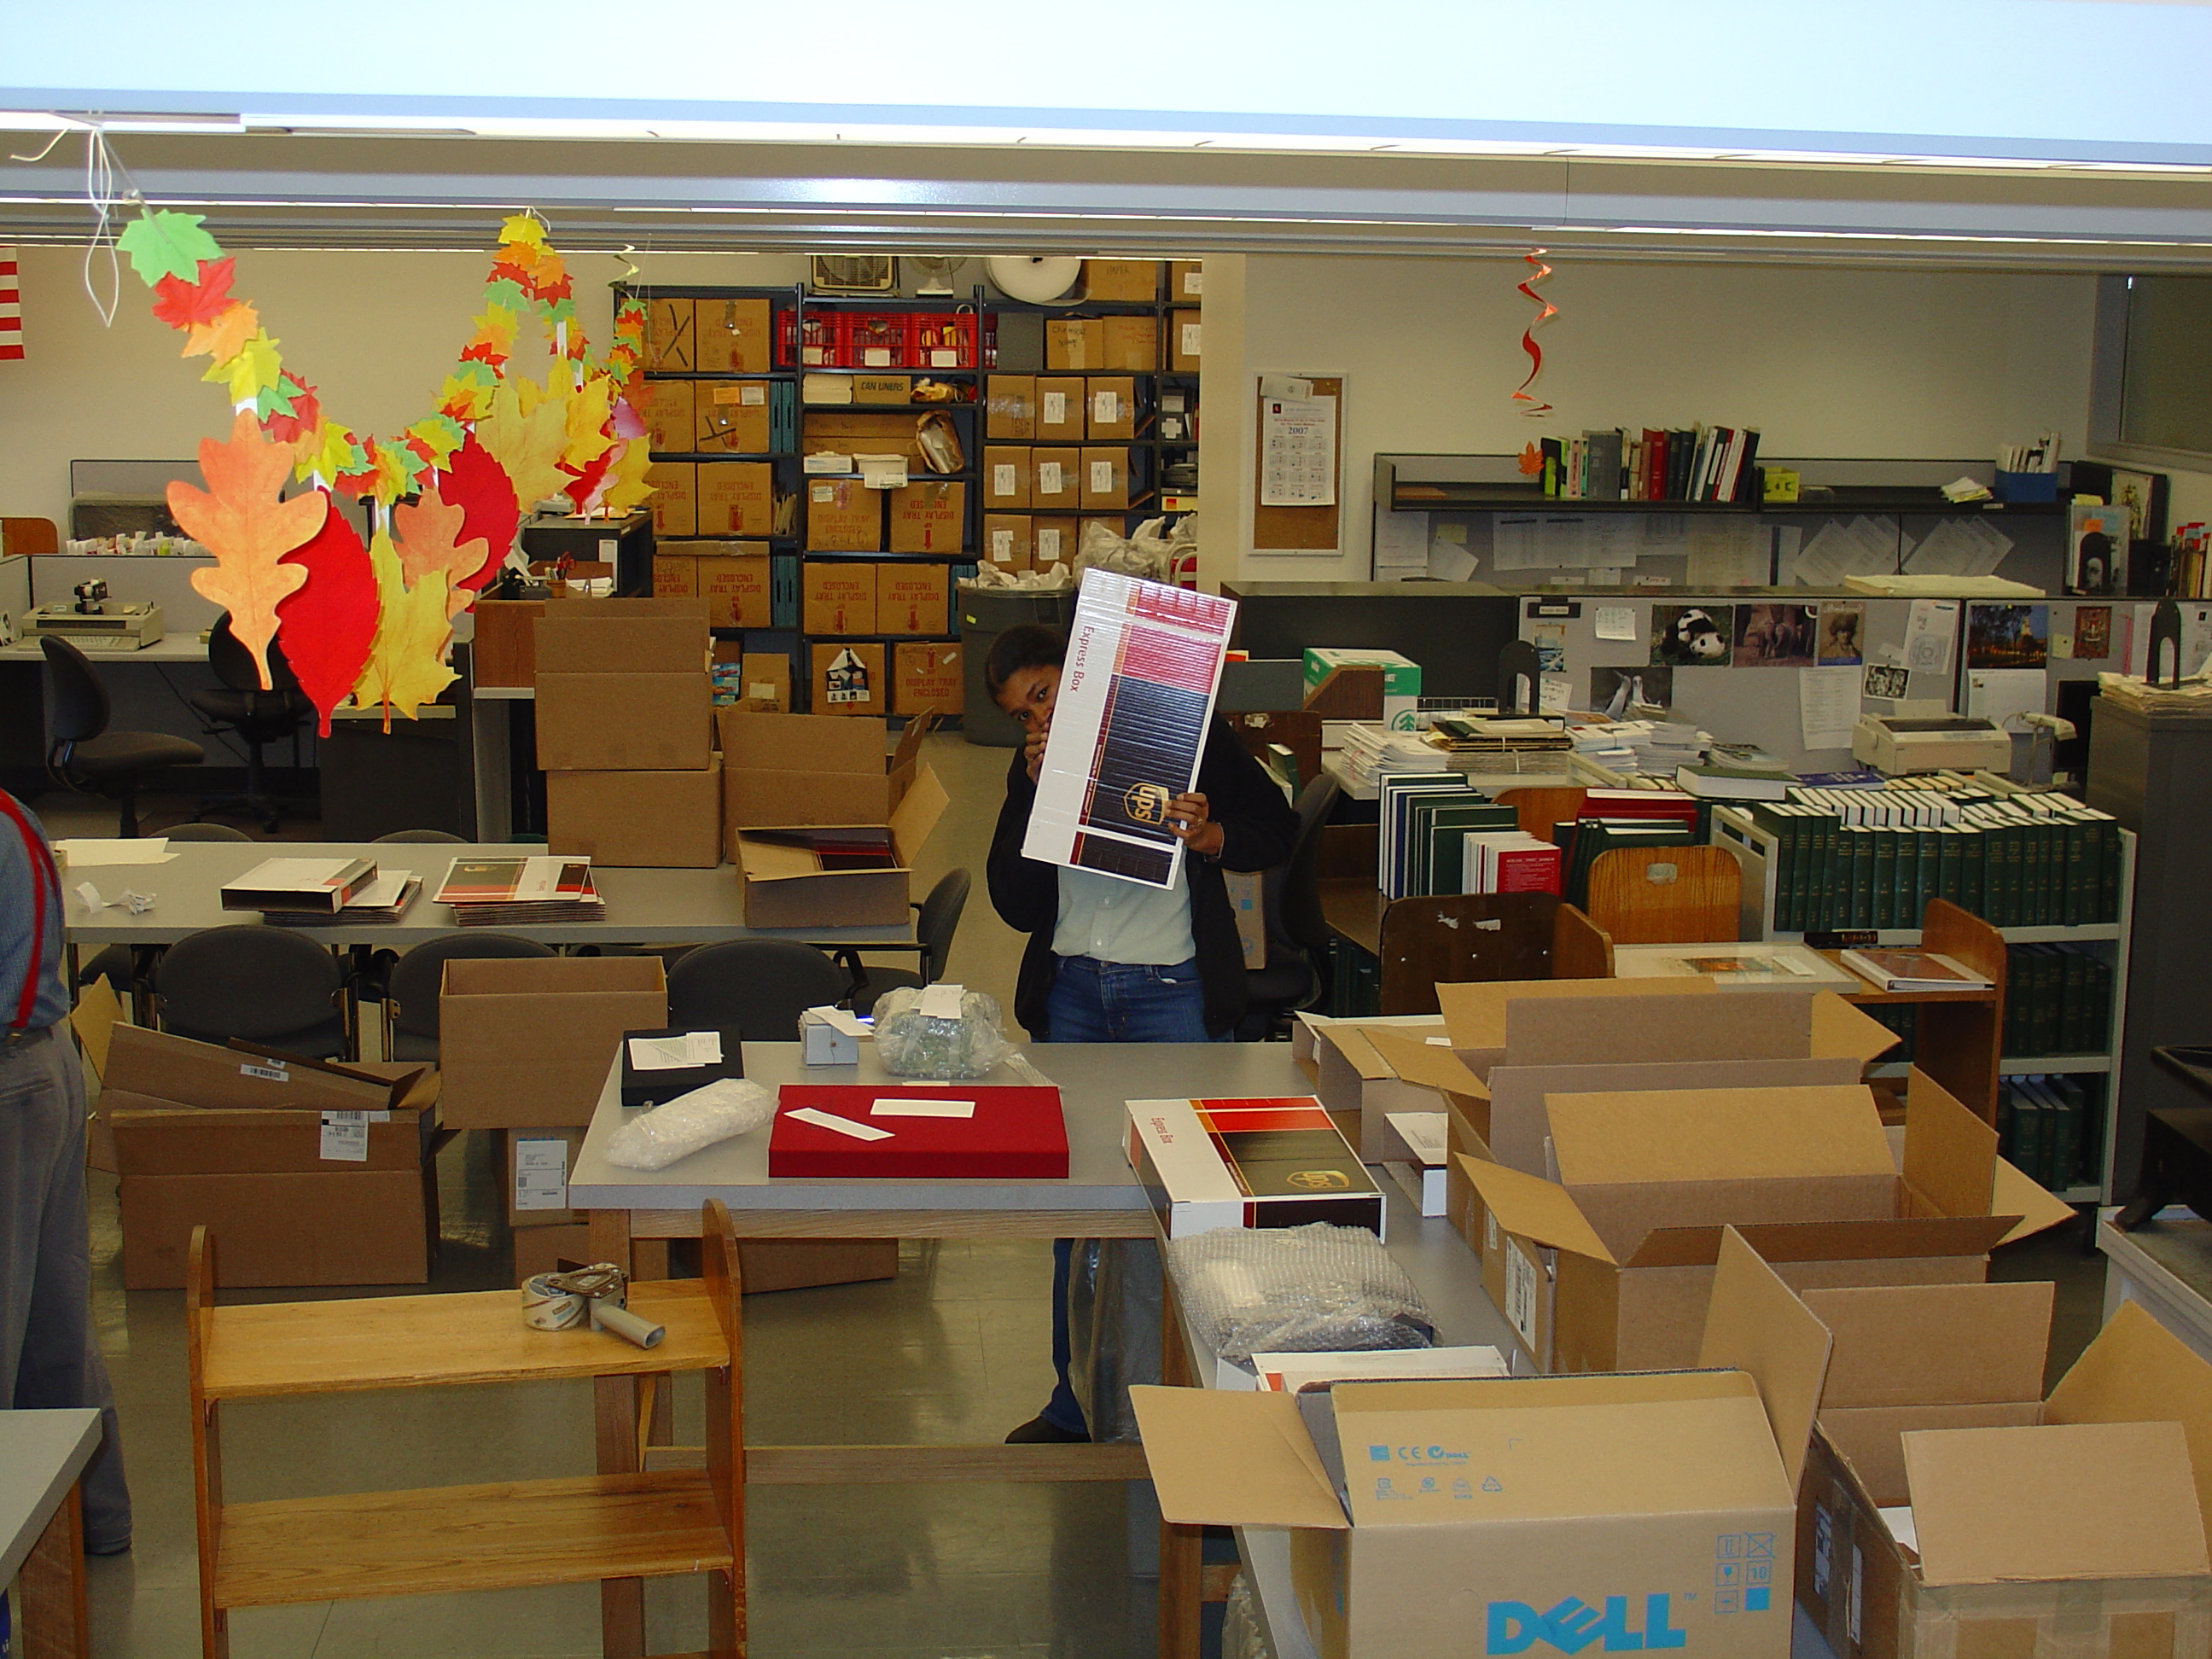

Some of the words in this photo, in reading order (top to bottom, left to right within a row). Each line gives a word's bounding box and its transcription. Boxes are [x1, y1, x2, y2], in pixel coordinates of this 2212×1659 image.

[861, 381, 876, 391] CAN
[878, 382, 904, 392] LINERS
[1288, 427, 1309, 435] 2007
[717, 481, 754, 490] ENCLOSED
[731, 492, 762, 501] DISPLAY
[910, 500, 947, 509] ENCSED
[902, 511, 921, 520] TRAY
[924, 511, 954, 520] DISPLAY
[717, 573, 754, 583] ENCLOSED
[709, 585, 728, 593] TRAY
[731, 585, 761, 593] DISPLAY
[823, 581, 859, 591] ENCLOSED
[895, 582, 932, 591] ENCLOSED
[815, 592, 833, 602] TRAY
[838, 592, 867, 602] DISPLAY
[888, 592, 906, 602] TRAY
[909, 592, 940, 602] DISPLAY
[1076, 626, 1094, 667] Express
[905, 678, 935, 687] DISPLAY
[940, 678, 957, 686] TRAY
[1070, 671, 1085, 692] Box
[913, 688, 949, 697] ENCLOSED
[1132, 784, 1155, 821] ups
[1150, 1117, 1168, 1133] Express
[1160, 1135, 1173, 1144] Box
[1751, 1566, 1767, 1580] 10
[1487, 1592, 1686, 1656] DELL
